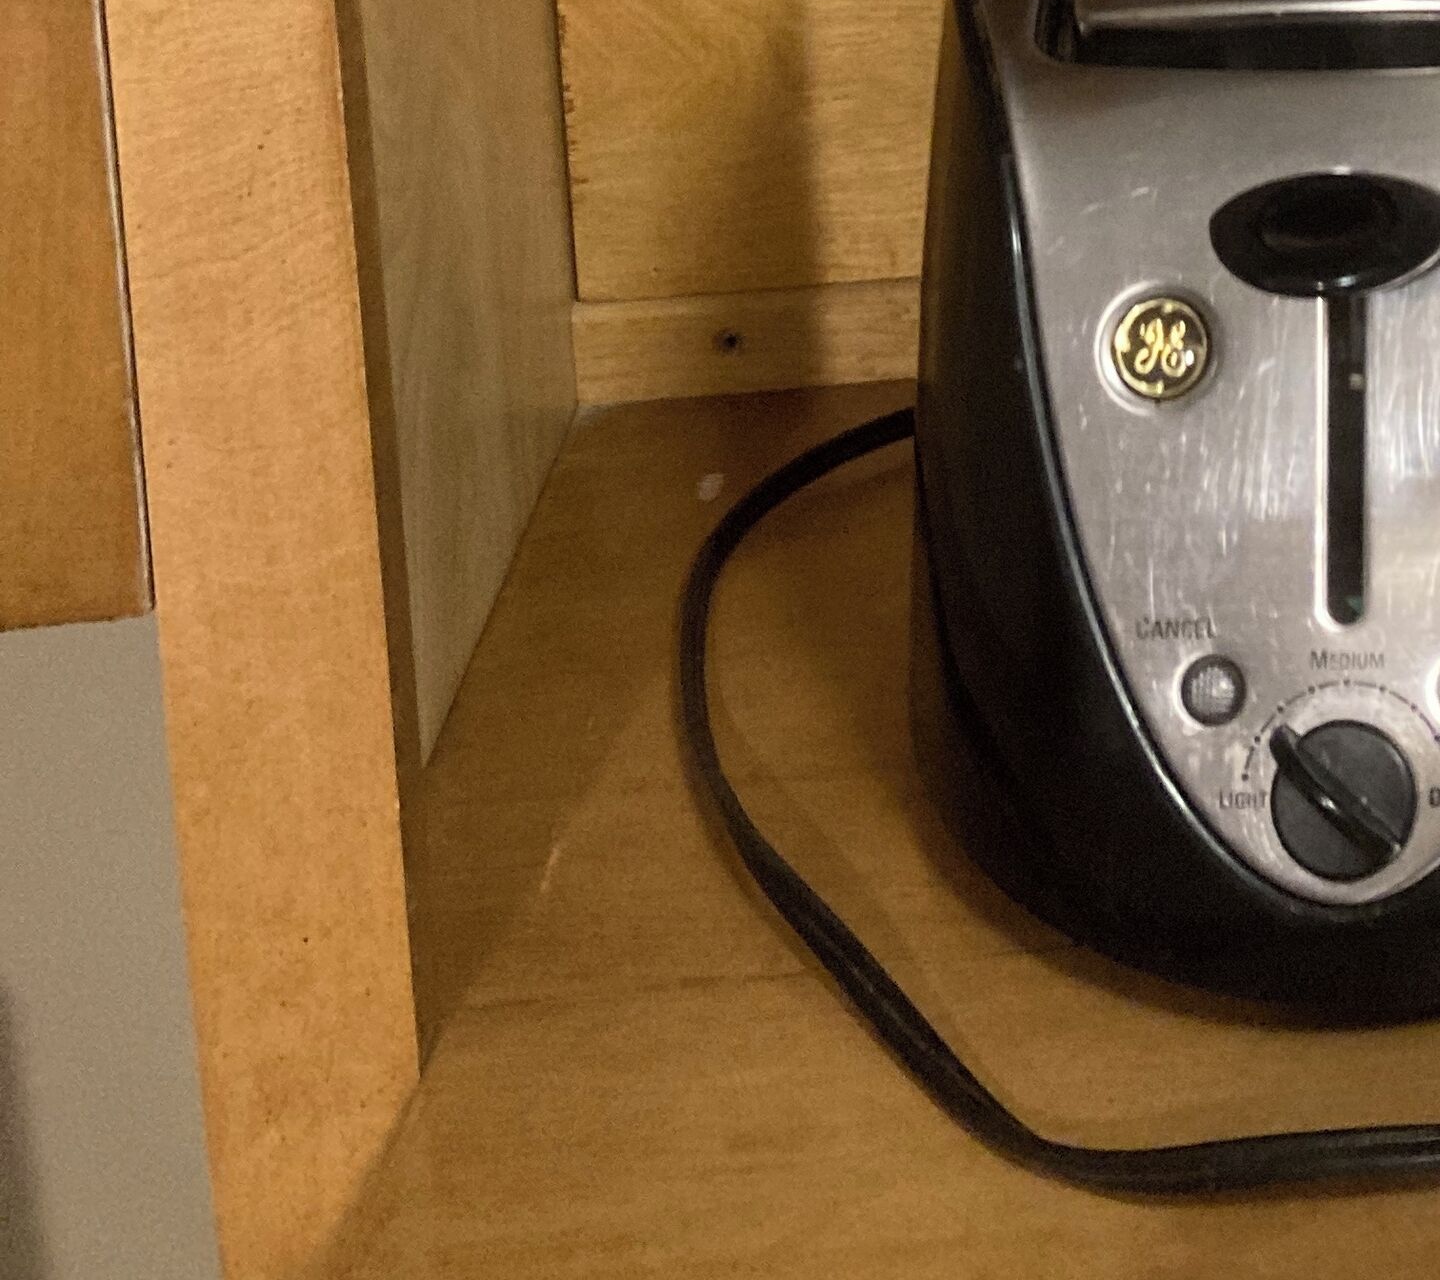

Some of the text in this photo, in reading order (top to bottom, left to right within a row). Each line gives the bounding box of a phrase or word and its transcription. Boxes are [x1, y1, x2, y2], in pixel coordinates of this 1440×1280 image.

[1136, 616, 1218, 639] CANCEL
[1310, 649, 1384, 671] MEDIUM
[1218, 790, 1267, 810] LIGHT
